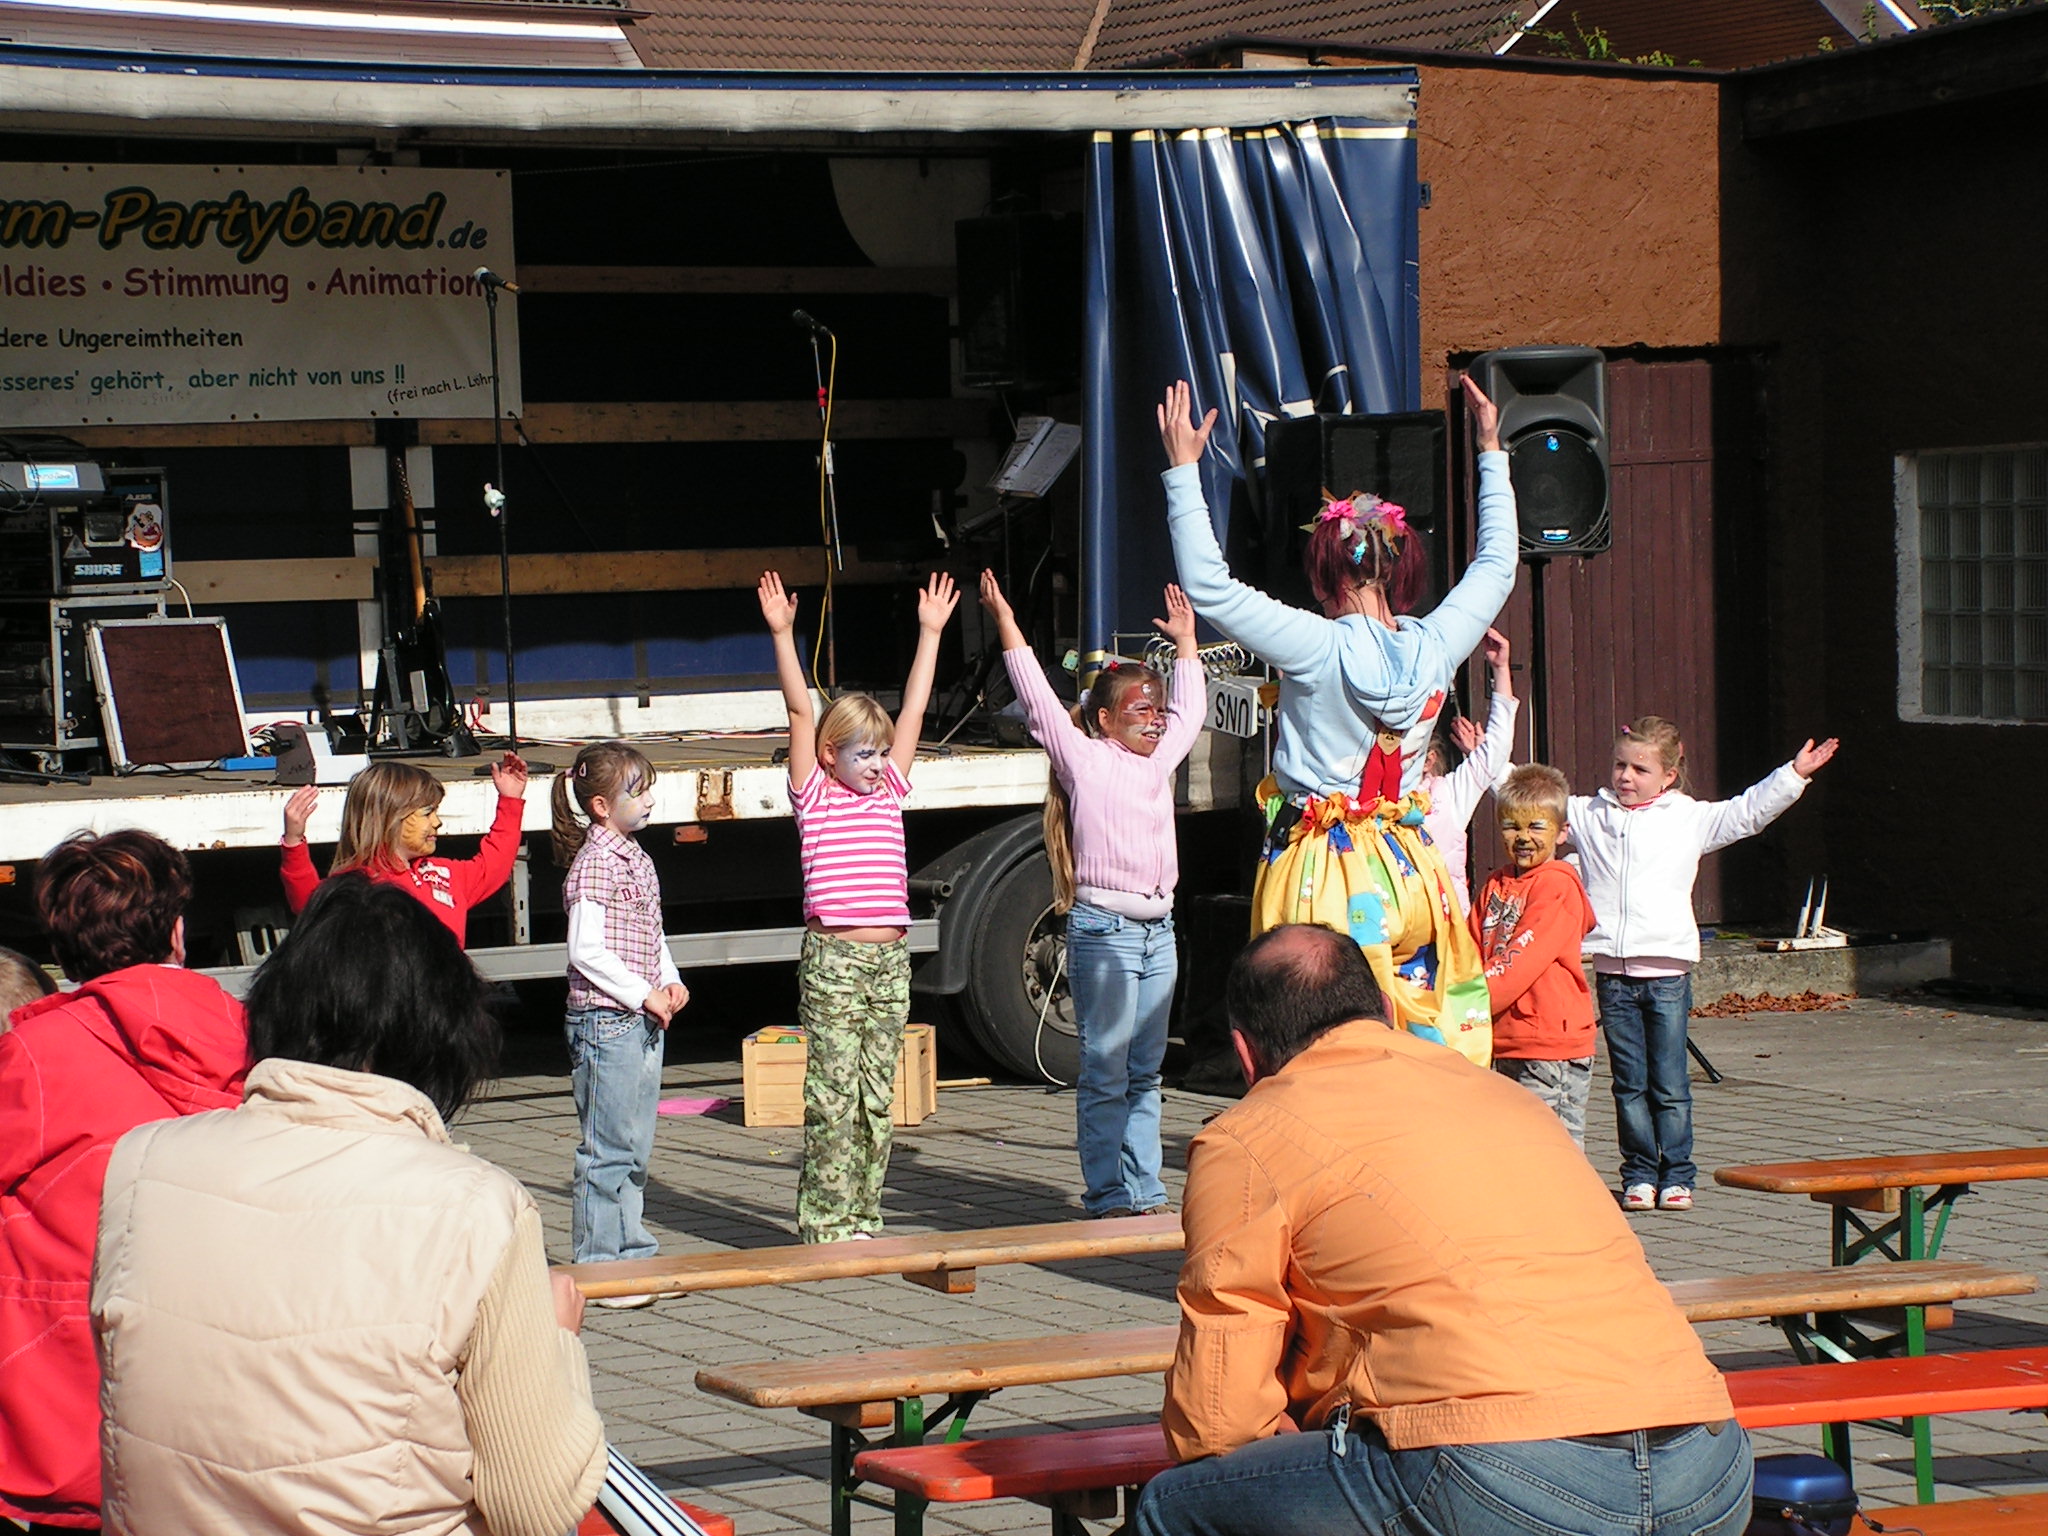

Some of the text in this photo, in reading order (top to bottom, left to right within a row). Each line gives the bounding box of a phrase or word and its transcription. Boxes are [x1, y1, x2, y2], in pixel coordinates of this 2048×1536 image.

[0, 186, 488, 264] m-Partyband.de
[0, 264, 482, 303] ldies Stimmung Animation
[58, 326, 244, 354] Ungereimtheiten
[0, 370, 80, 391] sseres'
[90, 370, 174, 396] gehört,
[188, 368, 240, 388] aber
[248, 366, 298, 386] nicht
[307, 369, 342, 385] von
[350, 369, 386, 385] uns
[387, 388, 419, 405] (frei
[422, 380, 452, 397] nach
[453, 377, 467, 391] L.
[74, 563, 123, 576] SHURE
